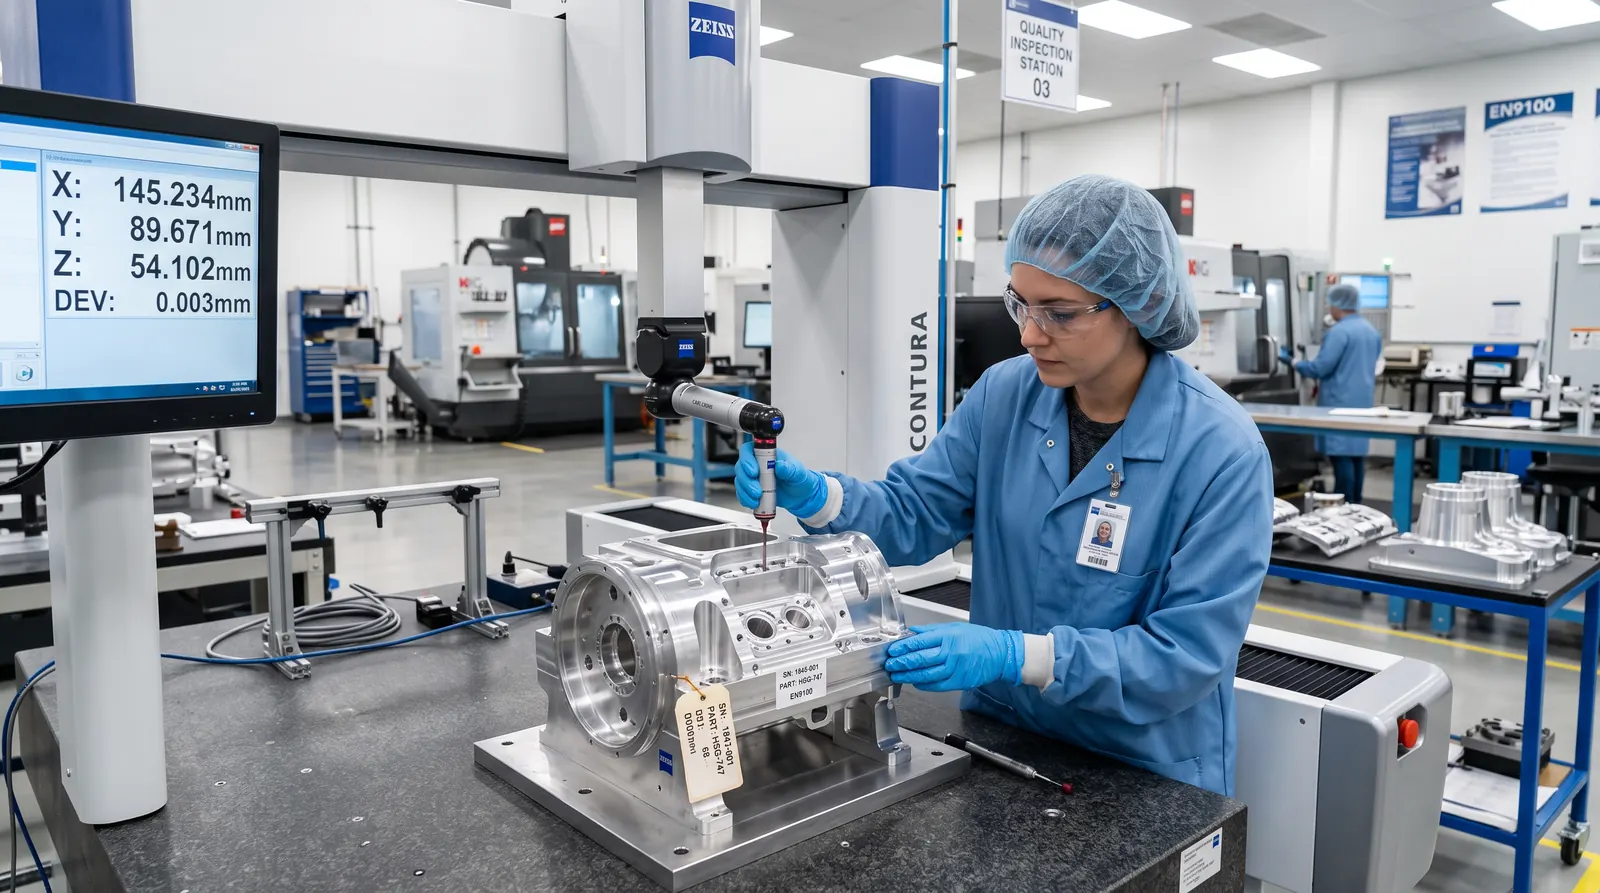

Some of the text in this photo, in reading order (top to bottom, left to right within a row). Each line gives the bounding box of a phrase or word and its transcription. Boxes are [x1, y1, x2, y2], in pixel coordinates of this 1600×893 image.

[690, 17, 734, 39] ZEISS
[1020, 20, 1064, 42] QUALITY
[1010, 36, 1073, 62] INSPECTION
[1020, 56, 1063, 77] STATION
[1033, 78, 1050, 98] 03
[1489, 97, 1556, 119] EN9100
[52, 170, 81, 199] X:
[52, 209, 81, 237] Y:
[53, 250, 81, 276] Z:
[55, 289, 114, 312] DEV:
[910, 311, 927, 452] CONTURA
[780, 680, 797, 690] PART:
[783, 670, 793, 678] SN:
[790, 688, 813, 700] EN9100
[718, 703, 727, 719] SN:
[712, 736, 725, 775] HSG-747
